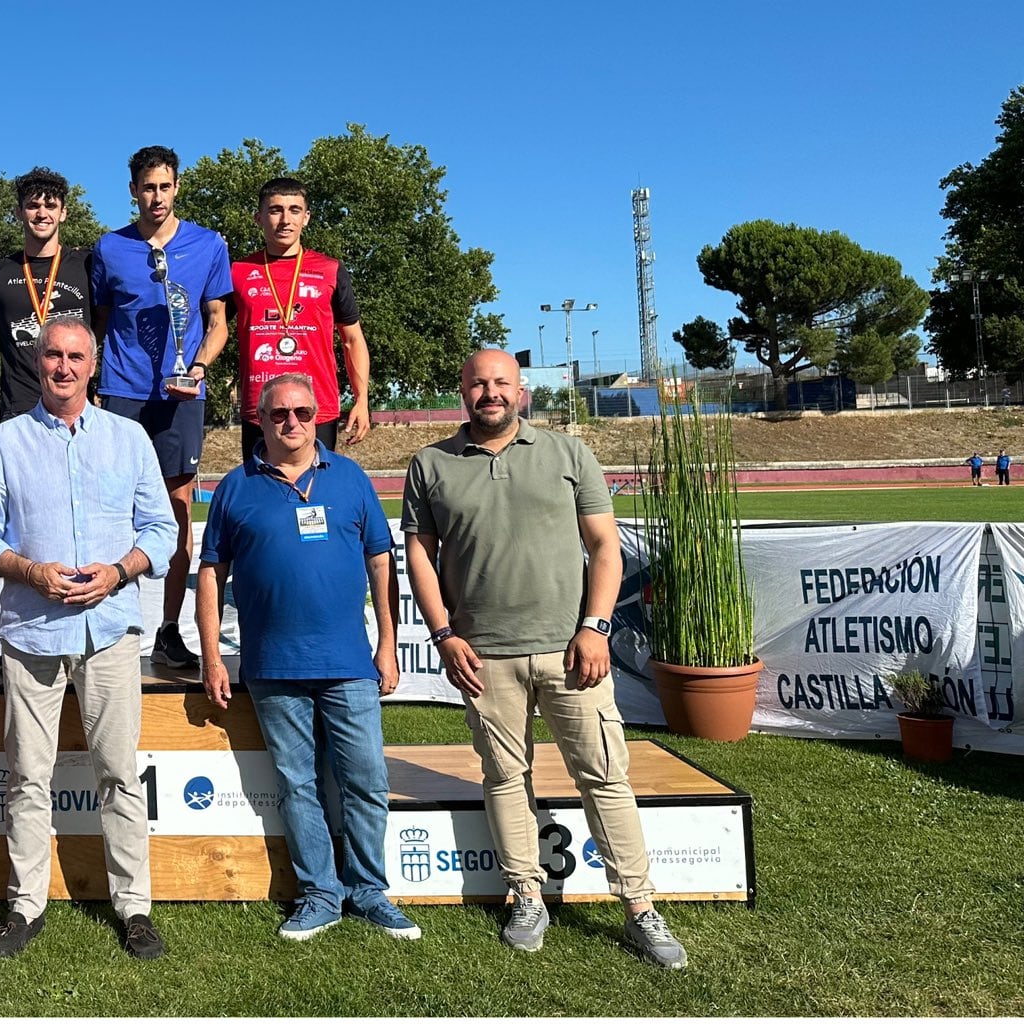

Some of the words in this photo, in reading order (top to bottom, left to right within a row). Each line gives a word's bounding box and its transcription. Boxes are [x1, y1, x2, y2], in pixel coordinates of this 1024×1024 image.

[800, 551, 942, 605] FEDERACIÓN
[805, 615, 933, 655] ATLETISMO
[777, 673, 893, 711] CASTILLA
[139, 765, 159, 821] 1
[217, 791, 280, 799] institutomu
[538, 823, 577, 881] 3
[646, 846, 721, 856] utomunicipal
[650, 856, 721, 866] rtessegovia
